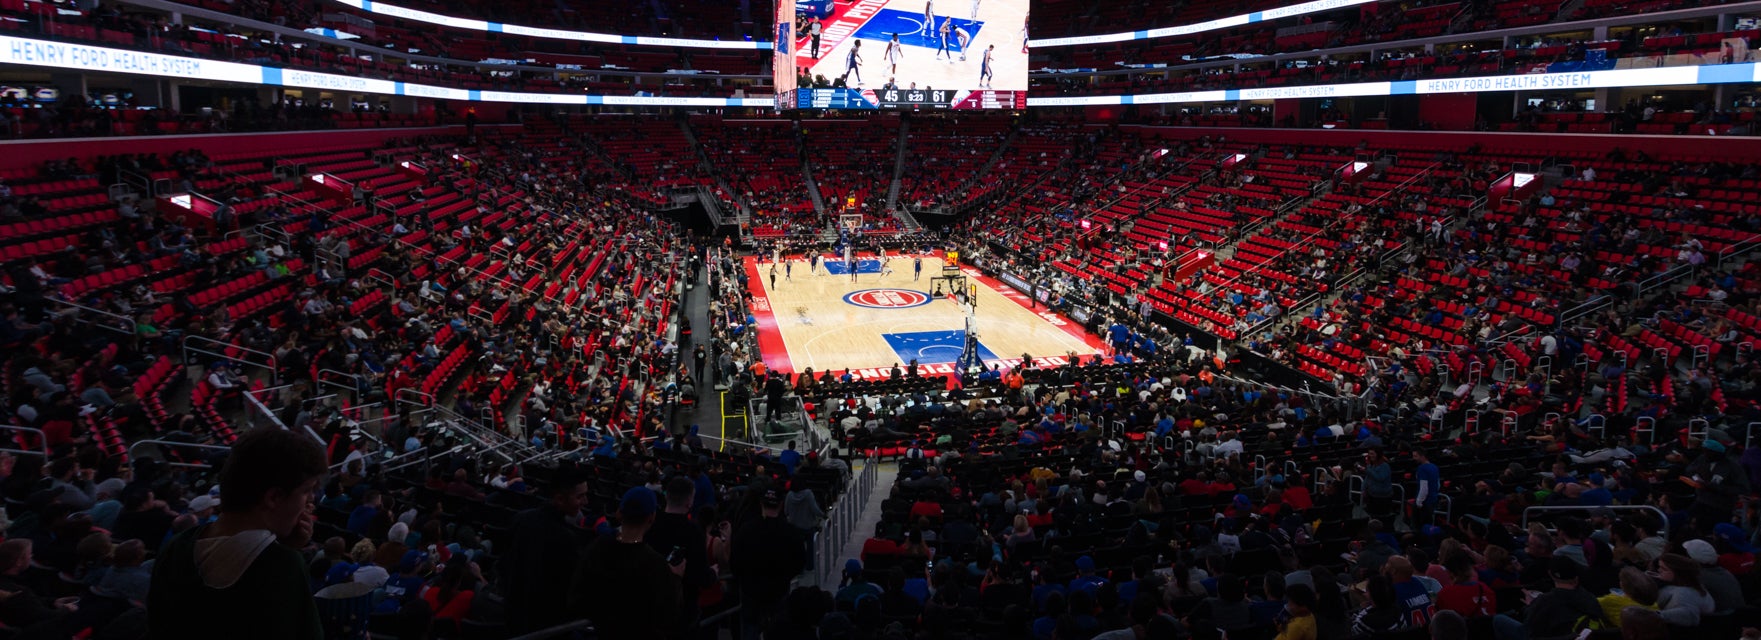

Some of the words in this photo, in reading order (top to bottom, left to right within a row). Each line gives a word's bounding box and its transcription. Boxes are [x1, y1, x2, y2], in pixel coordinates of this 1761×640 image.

[11, 40, 65, 64] HENRY
[72, 47, 108, 67] FORD
[114, 51, 158, 72] HEALTH
[162, 58, 201, 75] SYSTEM
[291, 72, 312, 85] HENRY
[313, 74, 328, 86] FORD
[329, 76, 348, 88] HEALTH
[349, 78, 367, 90] SYSTEM
[1428, 80, 1461, 92] HENRY
[1463, 78, 1491, 90] FORD
[1495, 76, 1538, 89] HEALTH
[1542, 73, 1591, 87] SYSTEM
[884, 90, 898, 102] 45
[908, 93, 924, 102] 9:23
[933, 90, 945, 102] 61
[1247, 90, 1265, 98] HENRY
[1266, 89, 1282, 97] FORD
[1283, 87, 1306, 96] HEALTH
[1308, 86, 1335, 96] SYSTEM
[1038, 312, 1067, 325] Jeep
